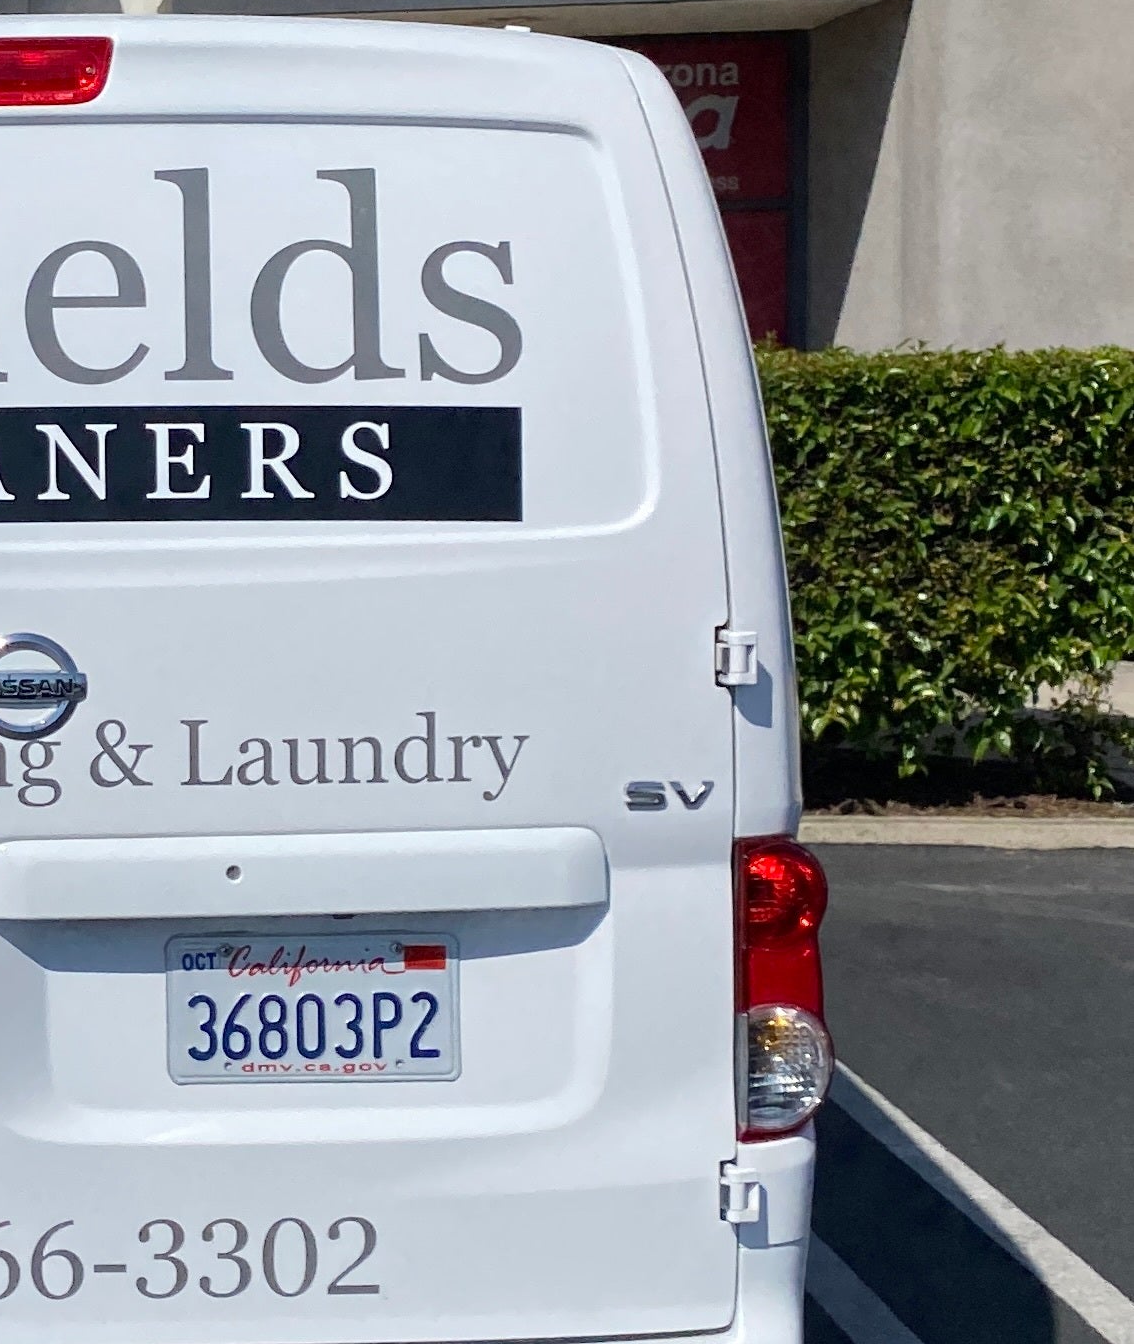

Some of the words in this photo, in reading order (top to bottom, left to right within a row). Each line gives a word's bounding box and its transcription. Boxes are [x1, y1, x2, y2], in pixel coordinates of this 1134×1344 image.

[88, 719, 153, 787] &
[180, 711, 530, 801] Laundry
[623, 780, 715, 812] SV
[181, 952, 217, 971] OCT
[227, 945, 405, 987] California
[187, 991, 441, 1061] 36803P2
[241, 1061, 389, 1075] dmv.ca.gov
